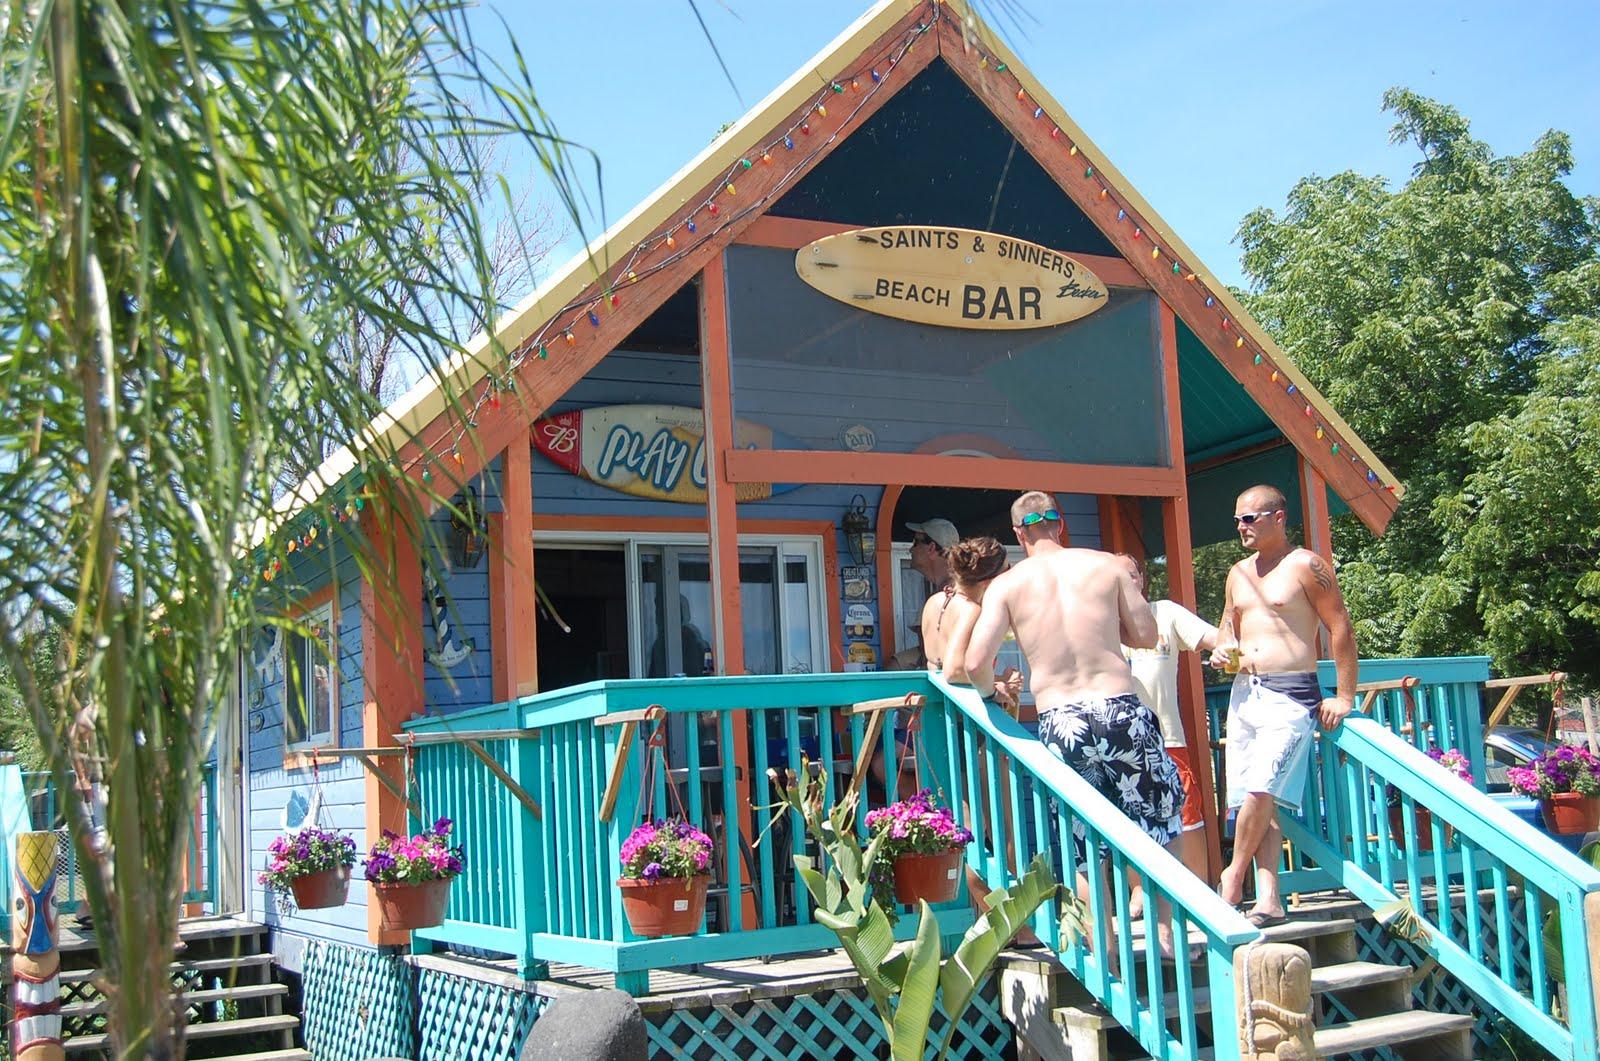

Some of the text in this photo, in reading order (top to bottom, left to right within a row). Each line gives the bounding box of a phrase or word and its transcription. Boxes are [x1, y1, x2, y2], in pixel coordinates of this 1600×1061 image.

[880, 230, 960, 249] SAINTS
[972, 236, 985, 252] &
[875, 278, 1042, 321] BEACH BAR
[600, 427, 688, 490] PLAY
[848, 609, 871, 617] Corona
